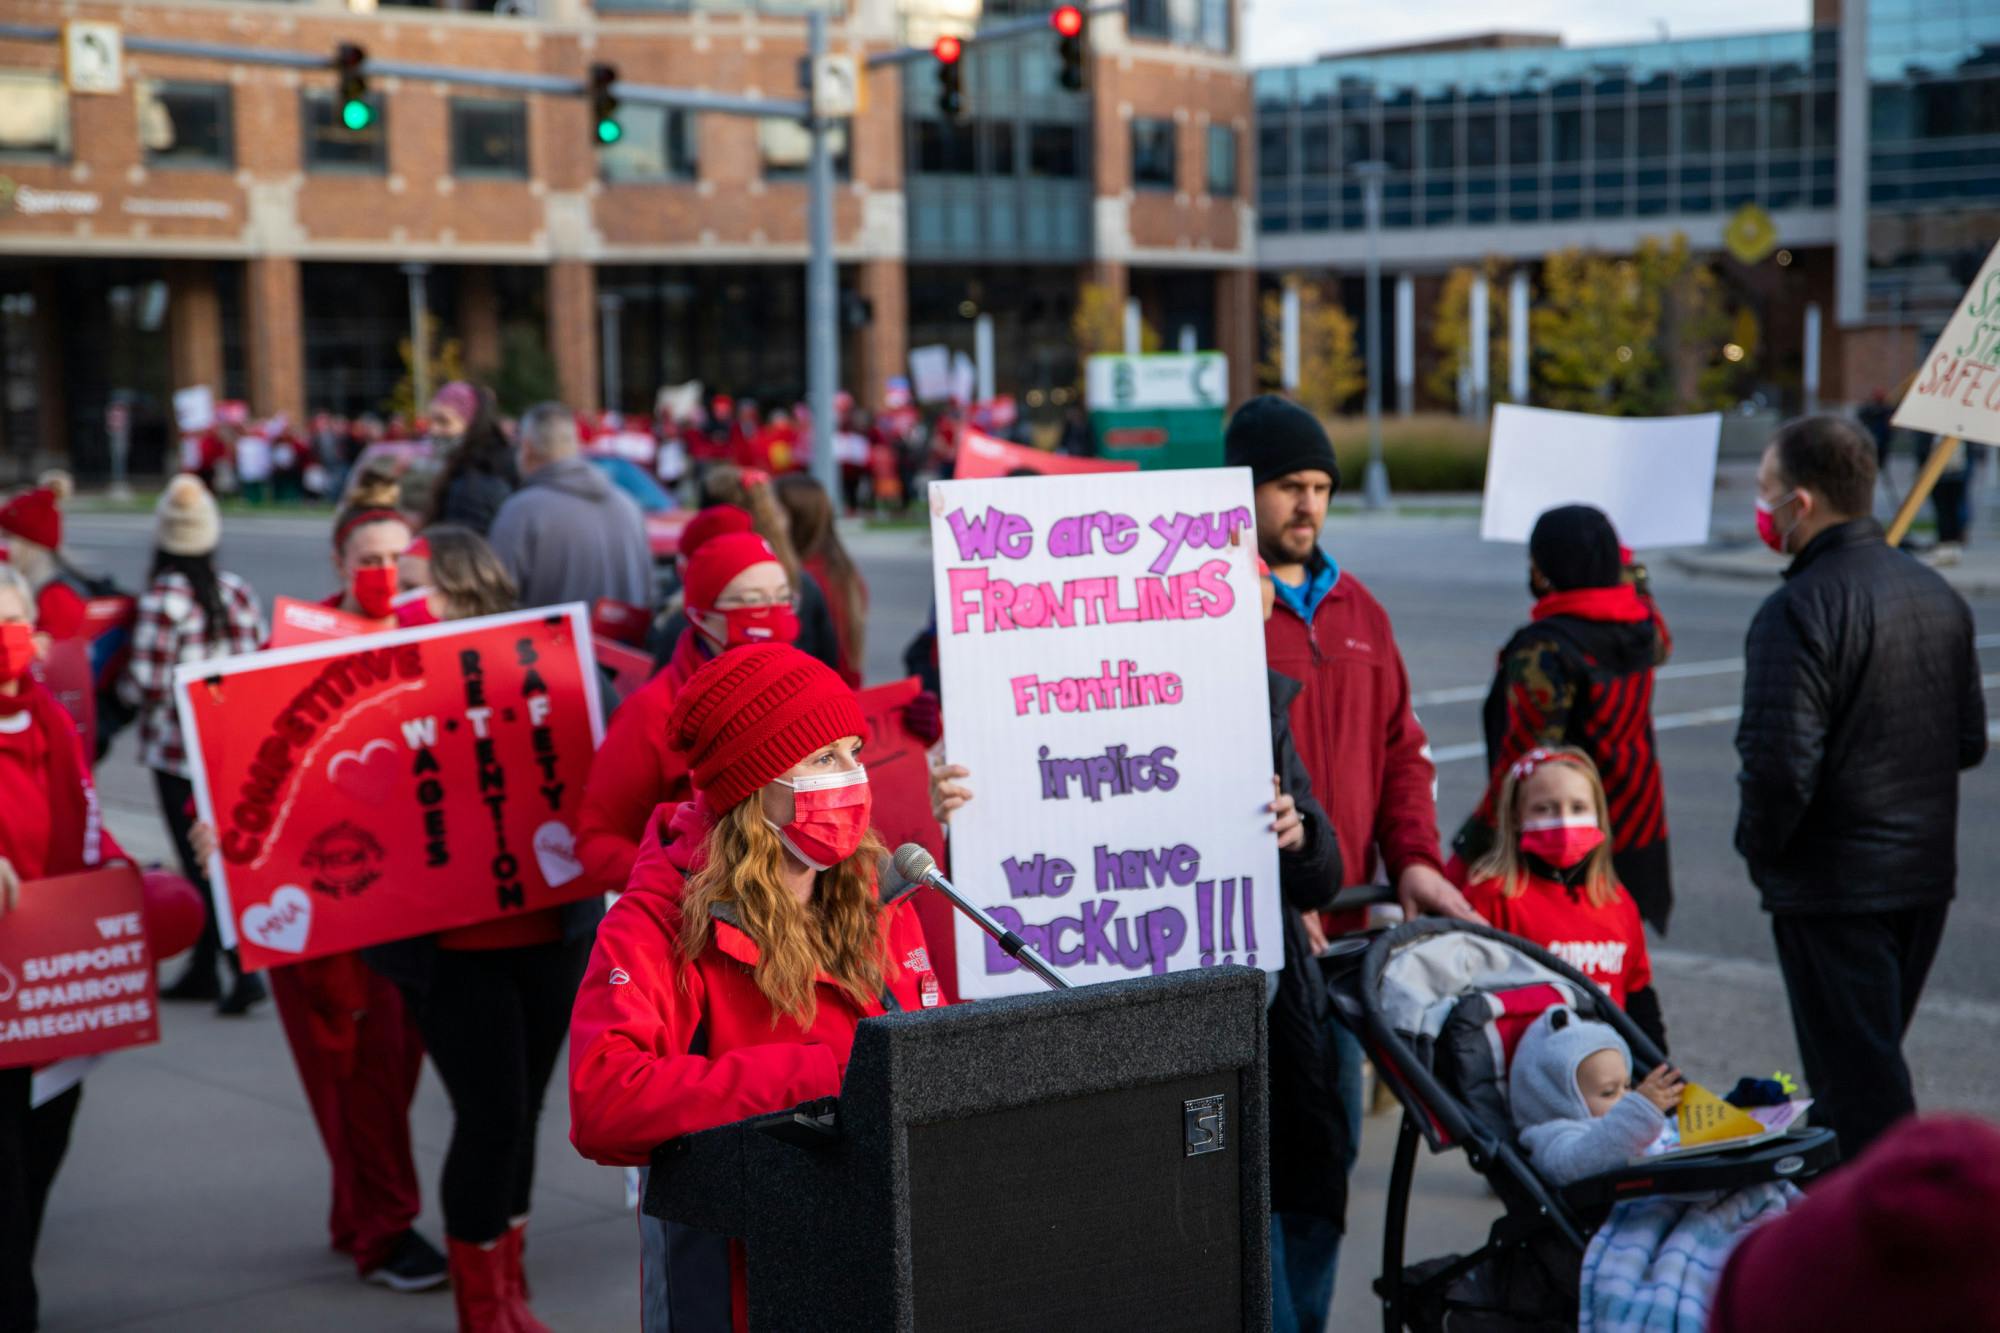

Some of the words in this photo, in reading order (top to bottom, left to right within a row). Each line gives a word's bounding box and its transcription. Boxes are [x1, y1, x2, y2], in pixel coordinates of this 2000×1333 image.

[1918, 351, 1996, 407] SAFE
[946, 505, 1033, 561] We
[1047, 510, 1139, 558] are
[1148, 506, 1252, 575] your
[946, 559, 1234, 635] FRONTLINES
[1010, 659, 1183, 716] Frontline
[222, 642, 424, 866] COMPETITIVE
[516, 637, 566, 812] SAFETY
[401, 715, 450, 868] WAGES
[460, 648, 526, 909] RETENTION
[1094, 844, 1200, 893] have
[96, 911, 143, 940] WE
[18, 971, 148, 1012] SPARROW
[22, 941, 144, 982] SUPPORT
